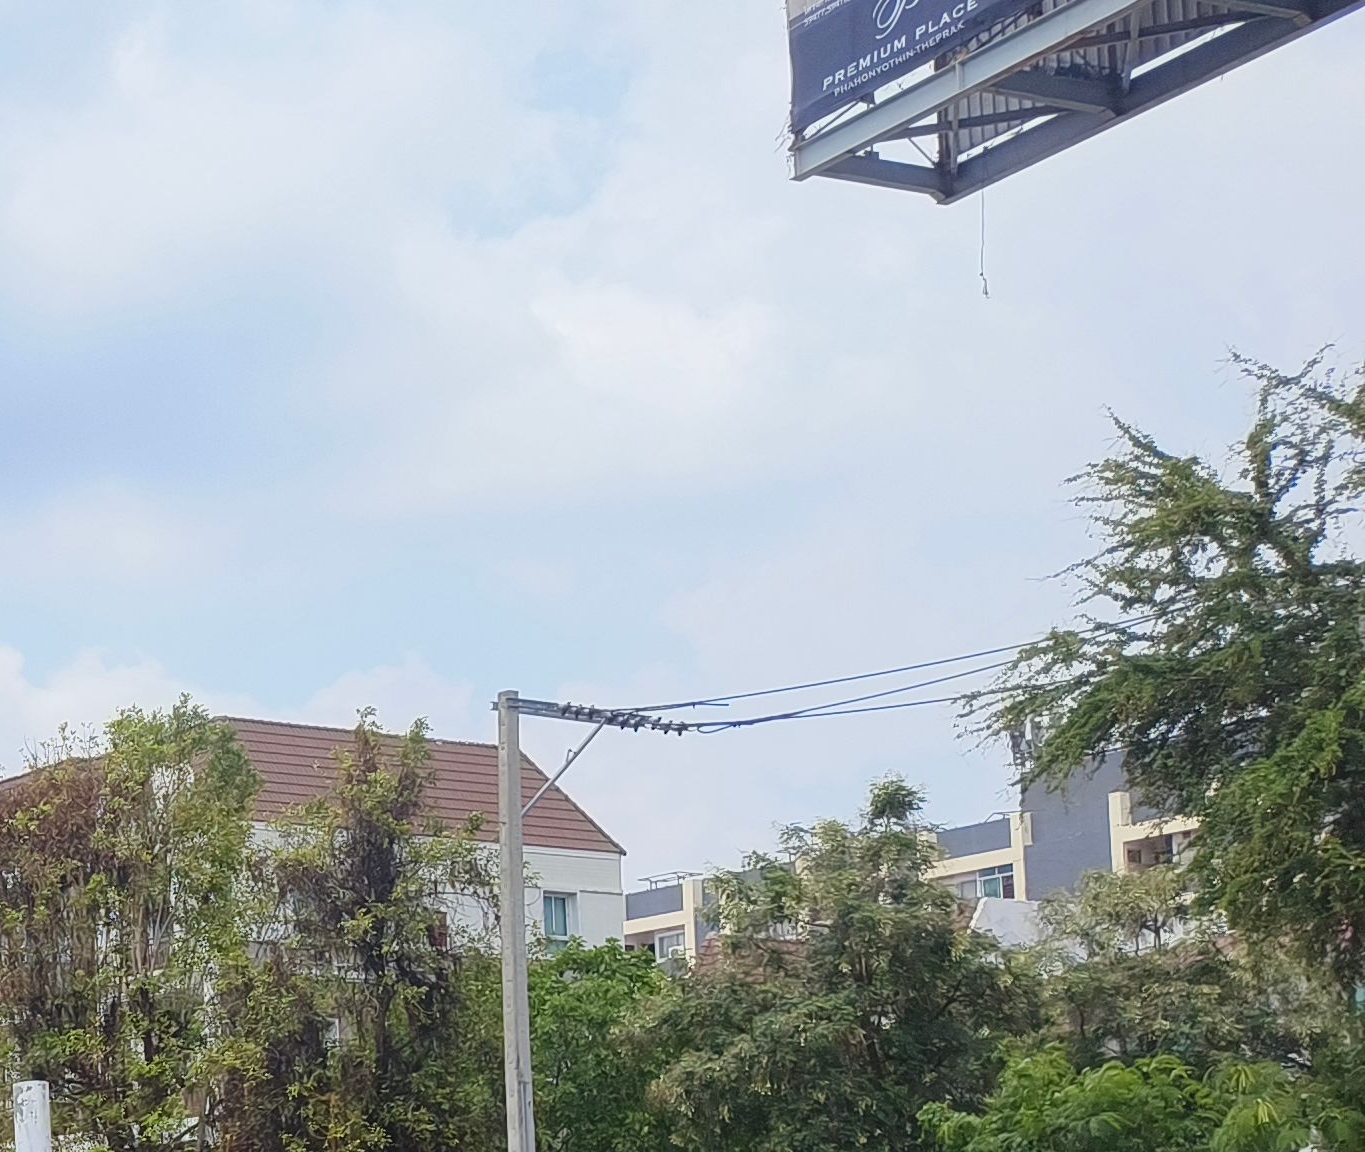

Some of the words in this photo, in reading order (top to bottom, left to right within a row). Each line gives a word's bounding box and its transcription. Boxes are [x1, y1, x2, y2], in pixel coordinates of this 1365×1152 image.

[822, 35, 906, 91] PREMIUM
[915, 0, 979, 40] PLACE
[834, 20, 966, 97] PHAHONYOTHIN-THEPRAK
